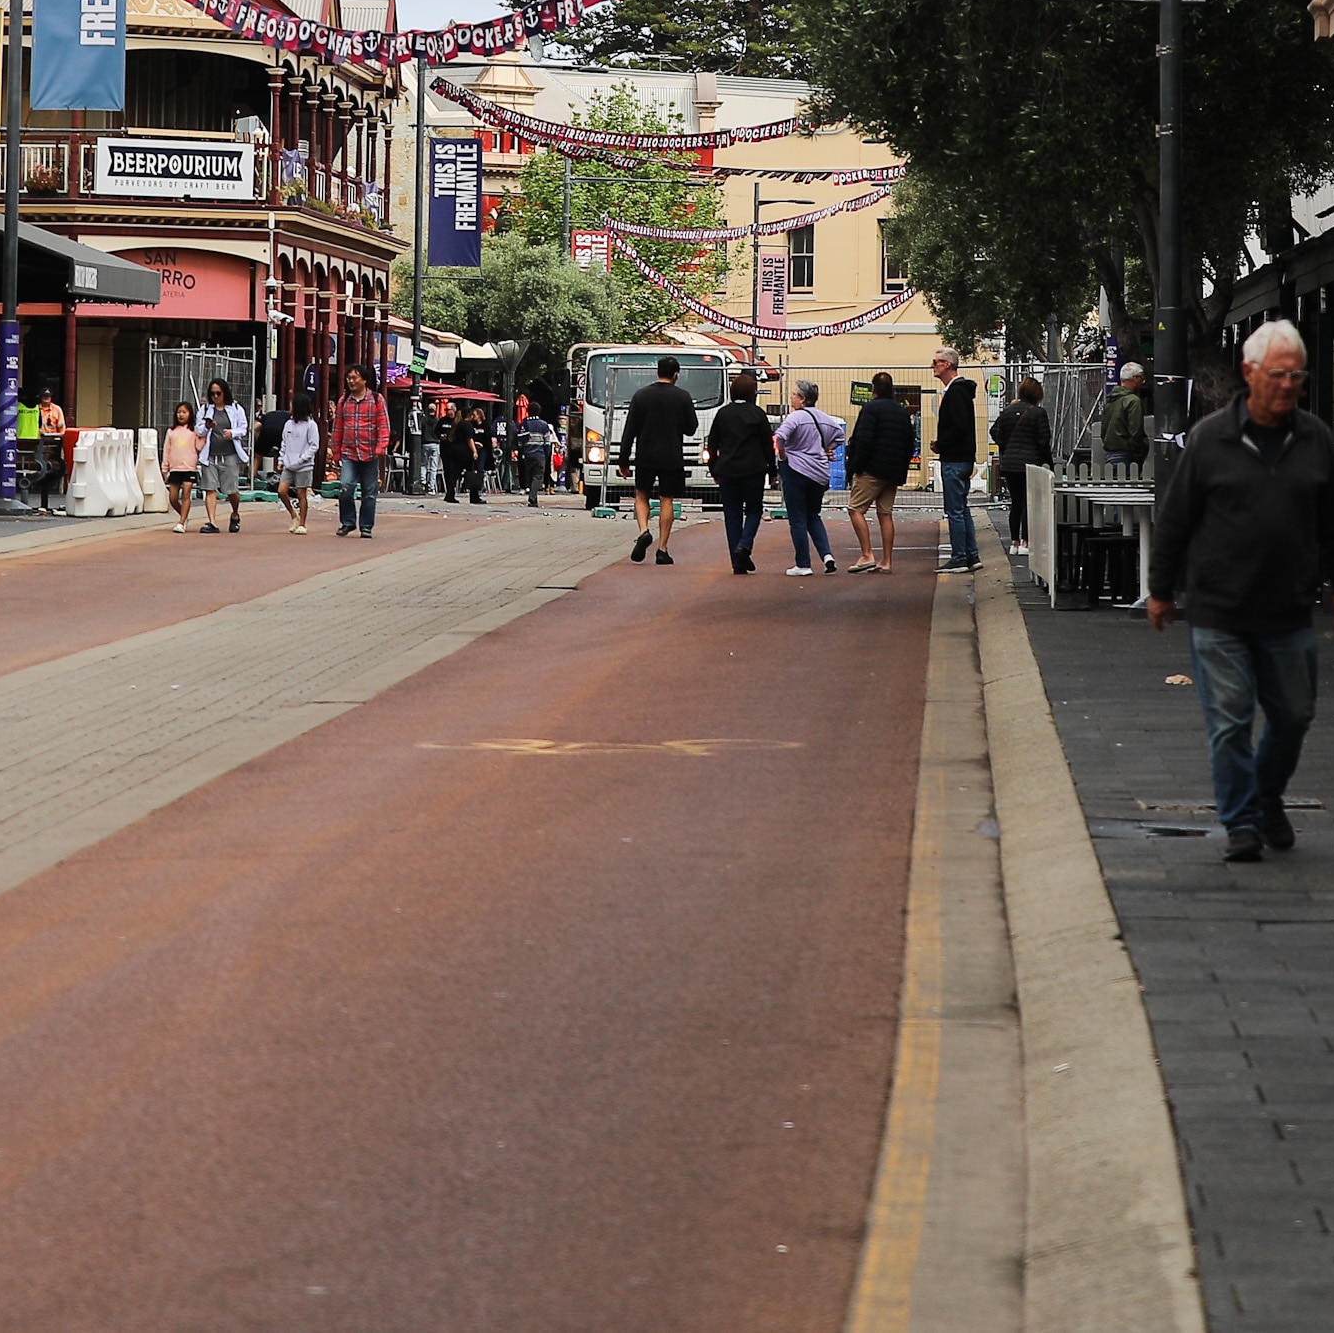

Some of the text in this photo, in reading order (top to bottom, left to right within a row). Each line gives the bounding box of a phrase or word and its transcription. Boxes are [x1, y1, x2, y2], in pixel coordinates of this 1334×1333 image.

[113, 151, 239, 178] BEERPOURIUM
[434, 143, 456, 198] THIS IS
[114, 179, 236, 191] PURVEYORS OF CRAFT BEER
[455, 143, 478, 231] FREMANTLE
[575, 234, 592, 247] IS
[144, 249, 177, 266] SAN
[157, 268, 196, 290] RRO
[762, 257, 774, 293] THIS IS
[772, 257, 785, 315] FREMANTLE
